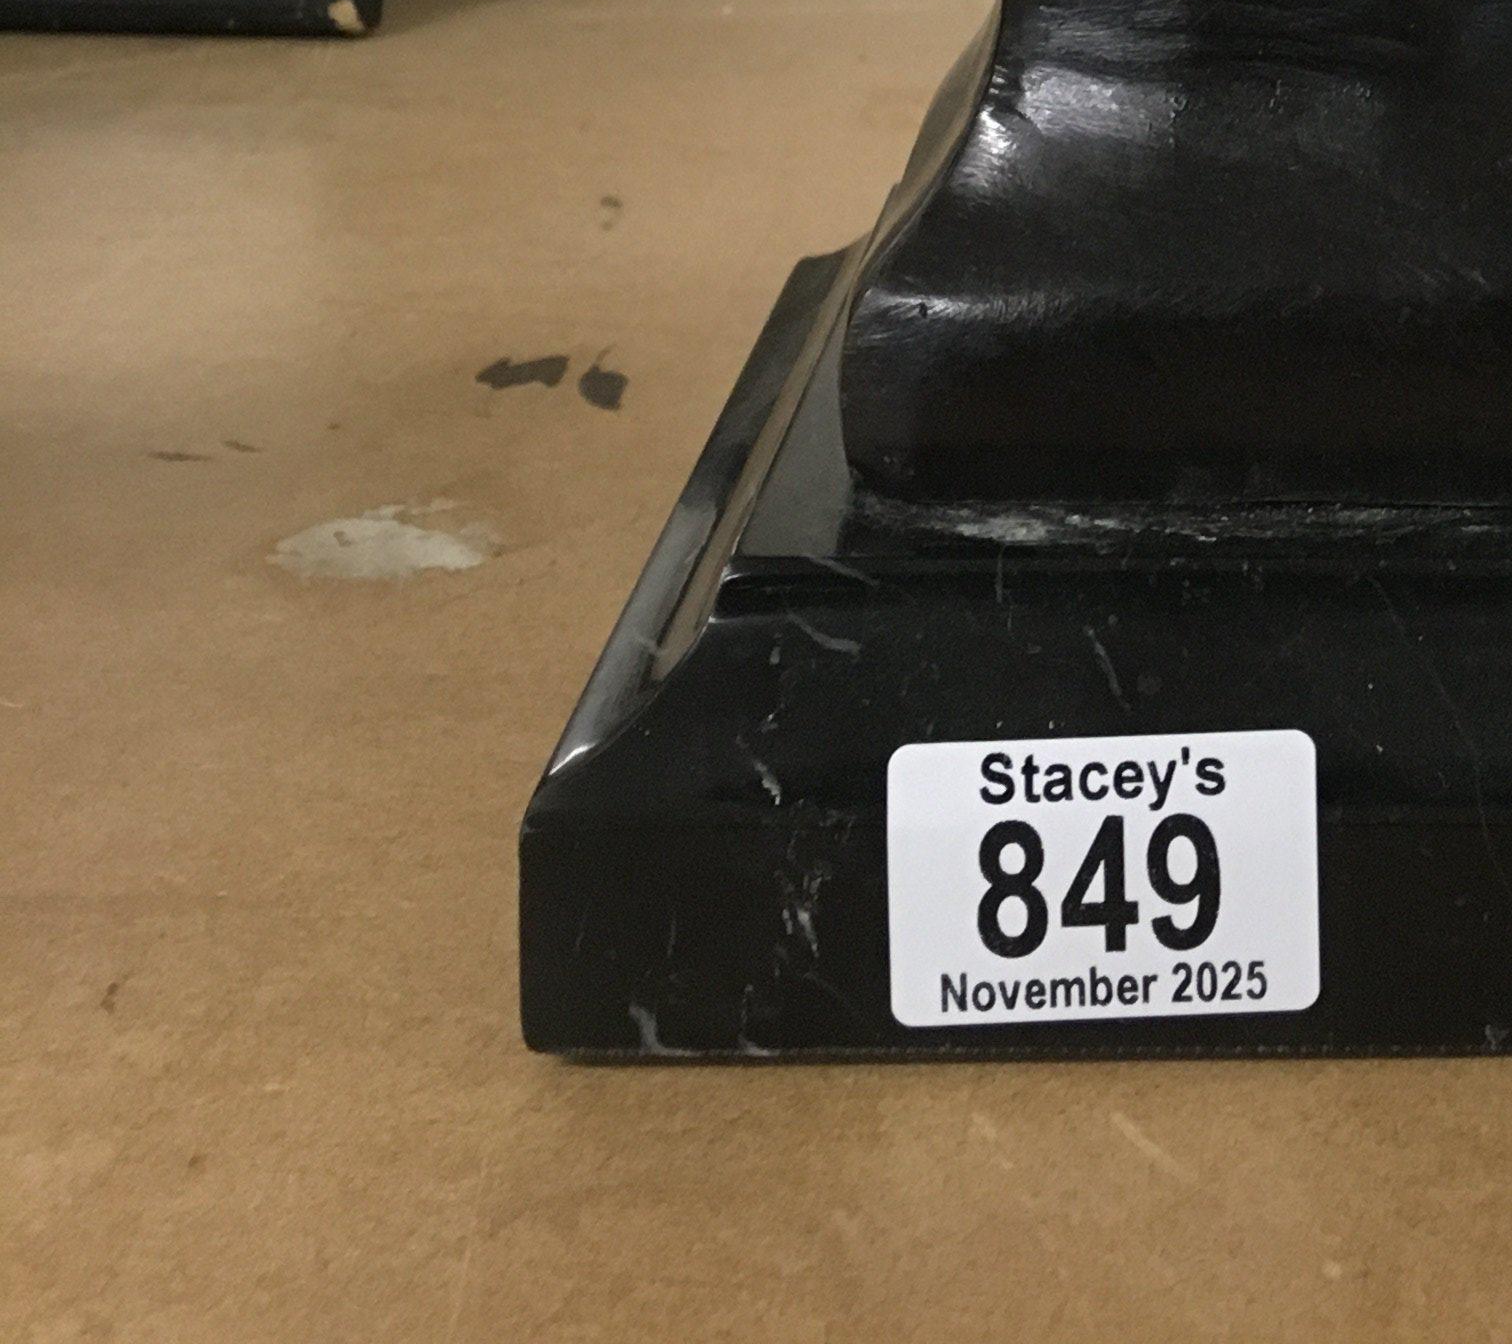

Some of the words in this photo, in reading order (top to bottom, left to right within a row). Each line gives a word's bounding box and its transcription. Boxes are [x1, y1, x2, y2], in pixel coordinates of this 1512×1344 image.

[979, 746, 1226, 812] Stacey's
[977, 812, 1222, 960] 849
[940, 966, 1158, 1013] November
[1171, 960, 1268, 1003] 2025
